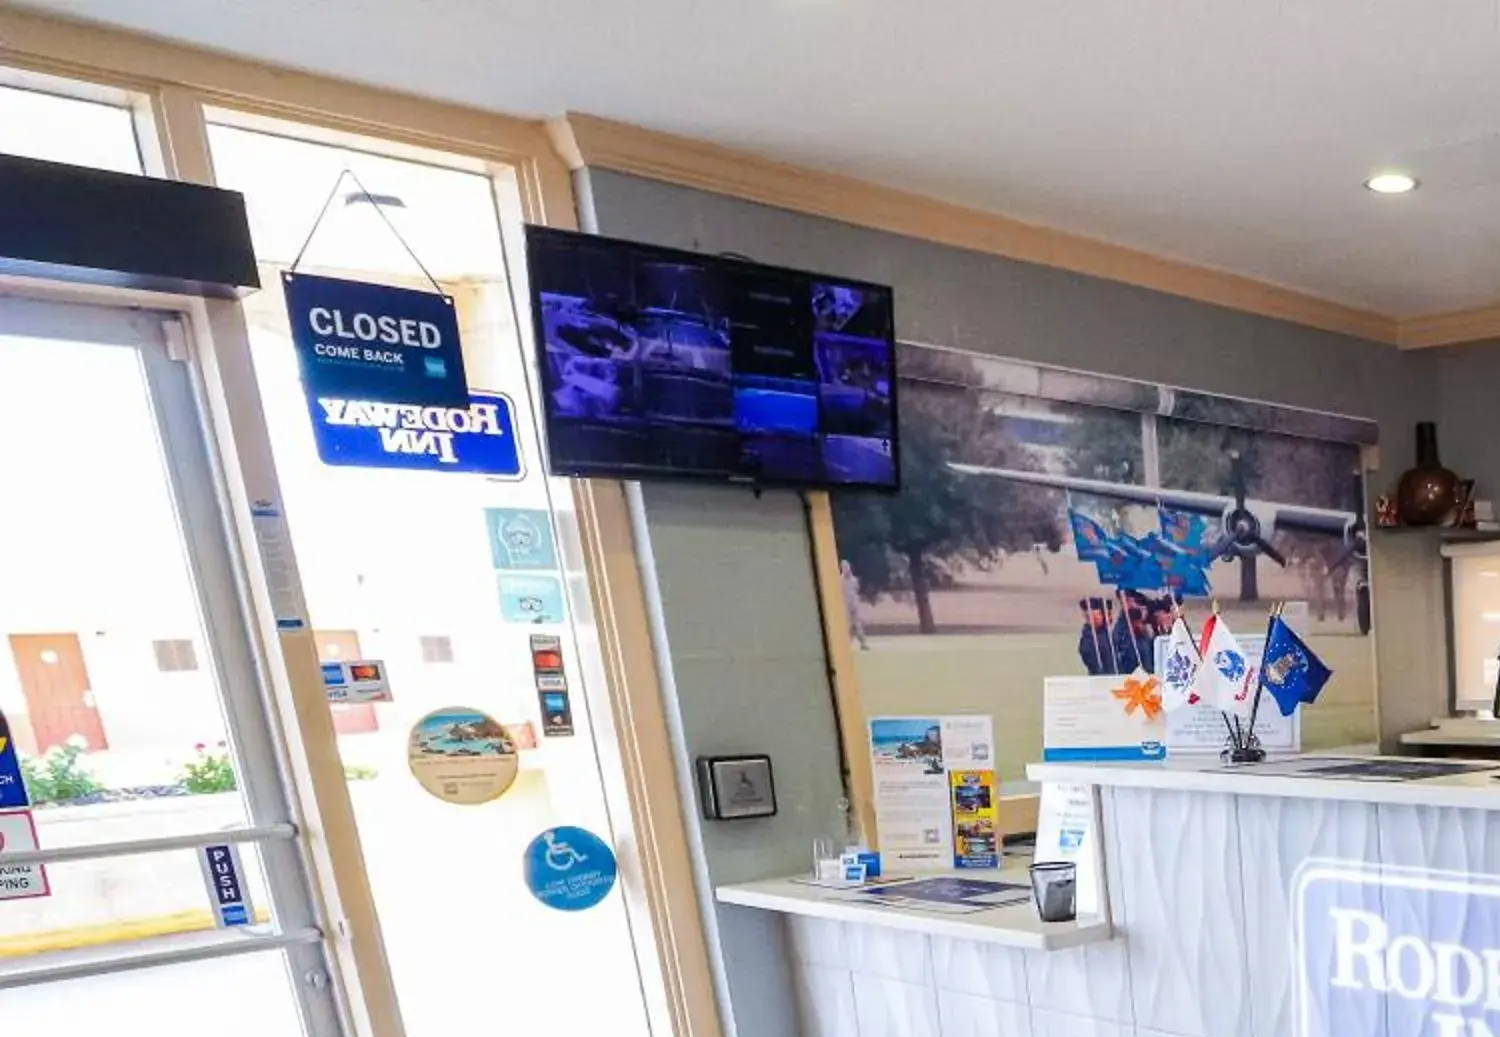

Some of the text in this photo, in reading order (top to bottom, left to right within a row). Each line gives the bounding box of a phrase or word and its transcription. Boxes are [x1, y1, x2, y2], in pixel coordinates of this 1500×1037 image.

[308, 306, 442, 349] CLOSED
[314, 343, 404, 364] COME BACK
[211, 849, 236, 900] PUSH
